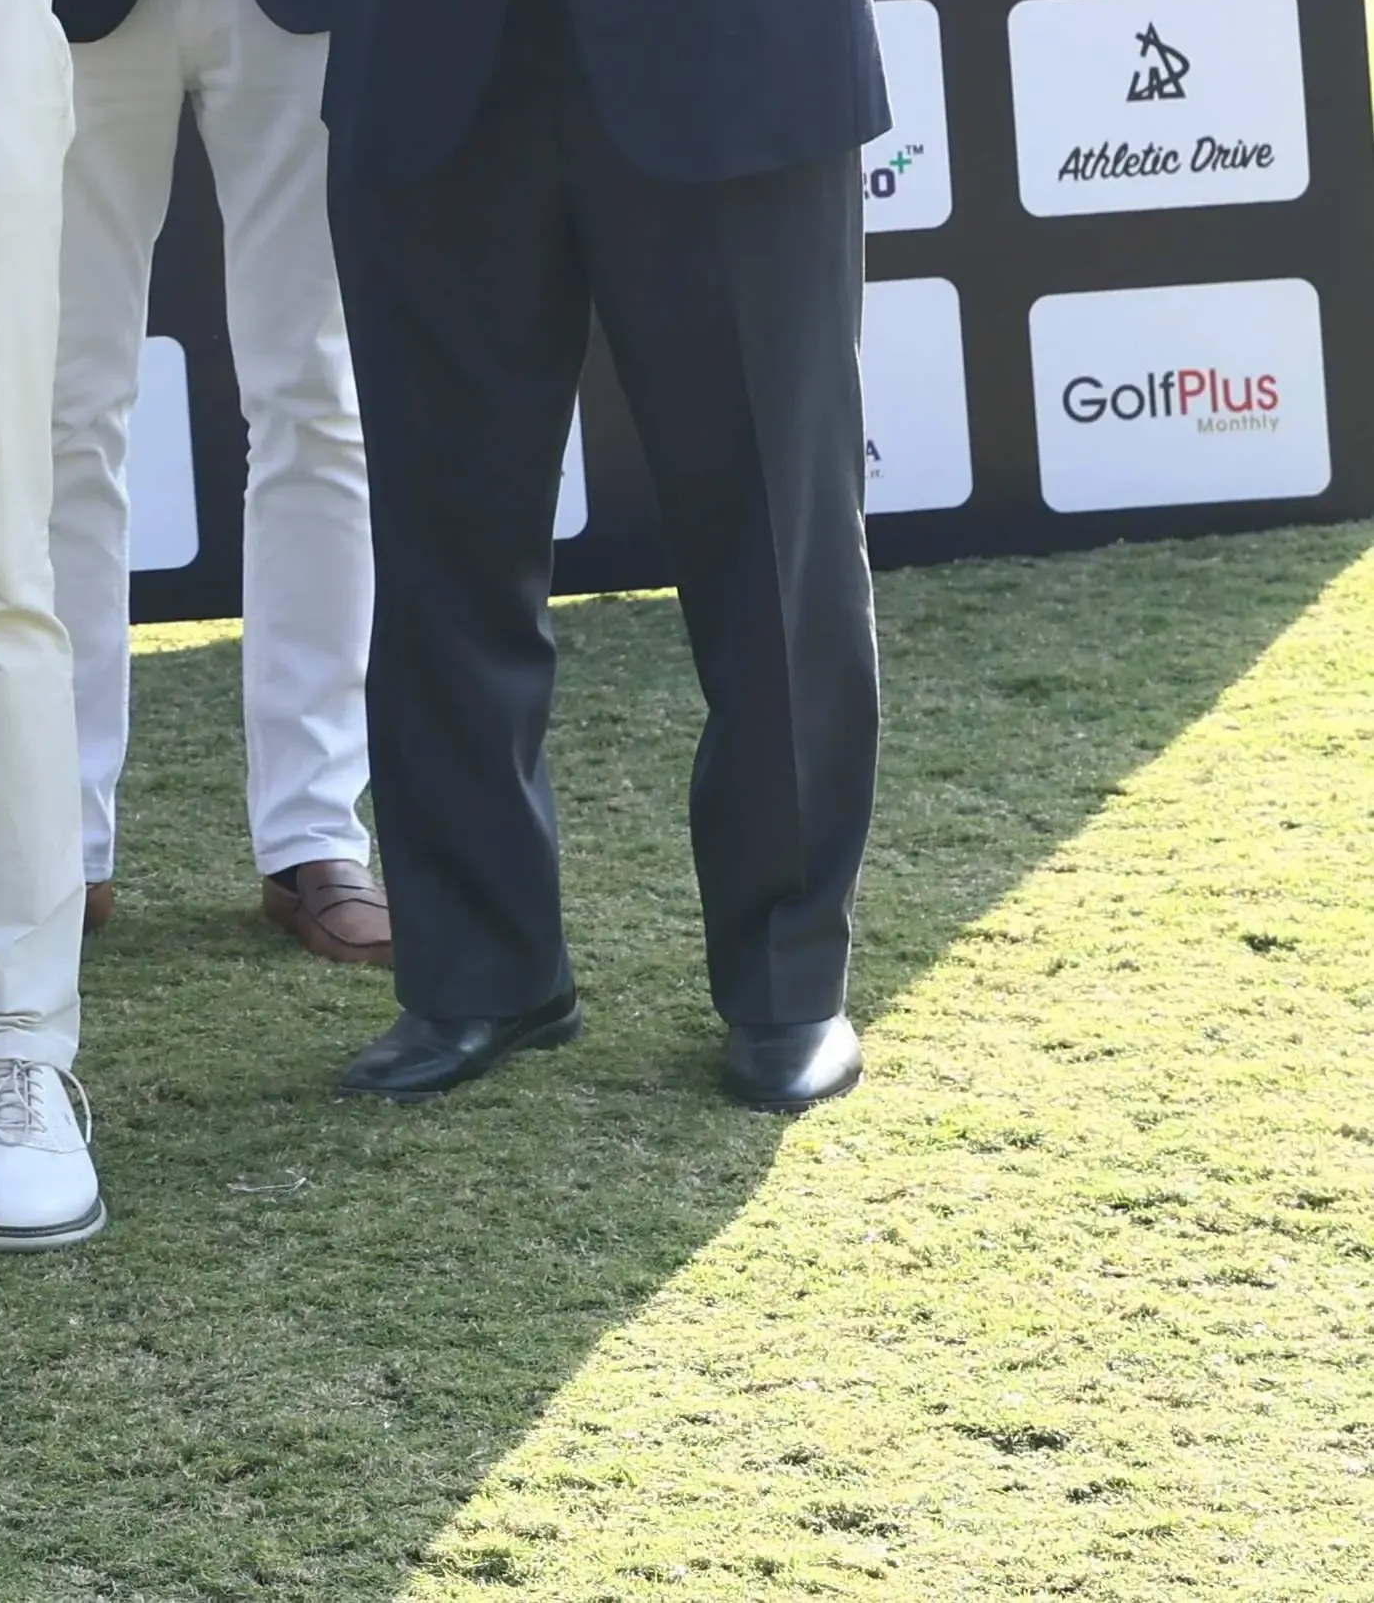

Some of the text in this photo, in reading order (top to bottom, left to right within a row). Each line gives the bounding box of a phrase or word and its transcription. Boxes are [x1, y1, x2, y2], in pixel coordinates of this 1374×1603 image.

[1058, 135, 1275, 182] Athletic Drive
[1062, 368, 1280, 424] GolfPlus
[1197, 414, 1280, 434] Monthly
